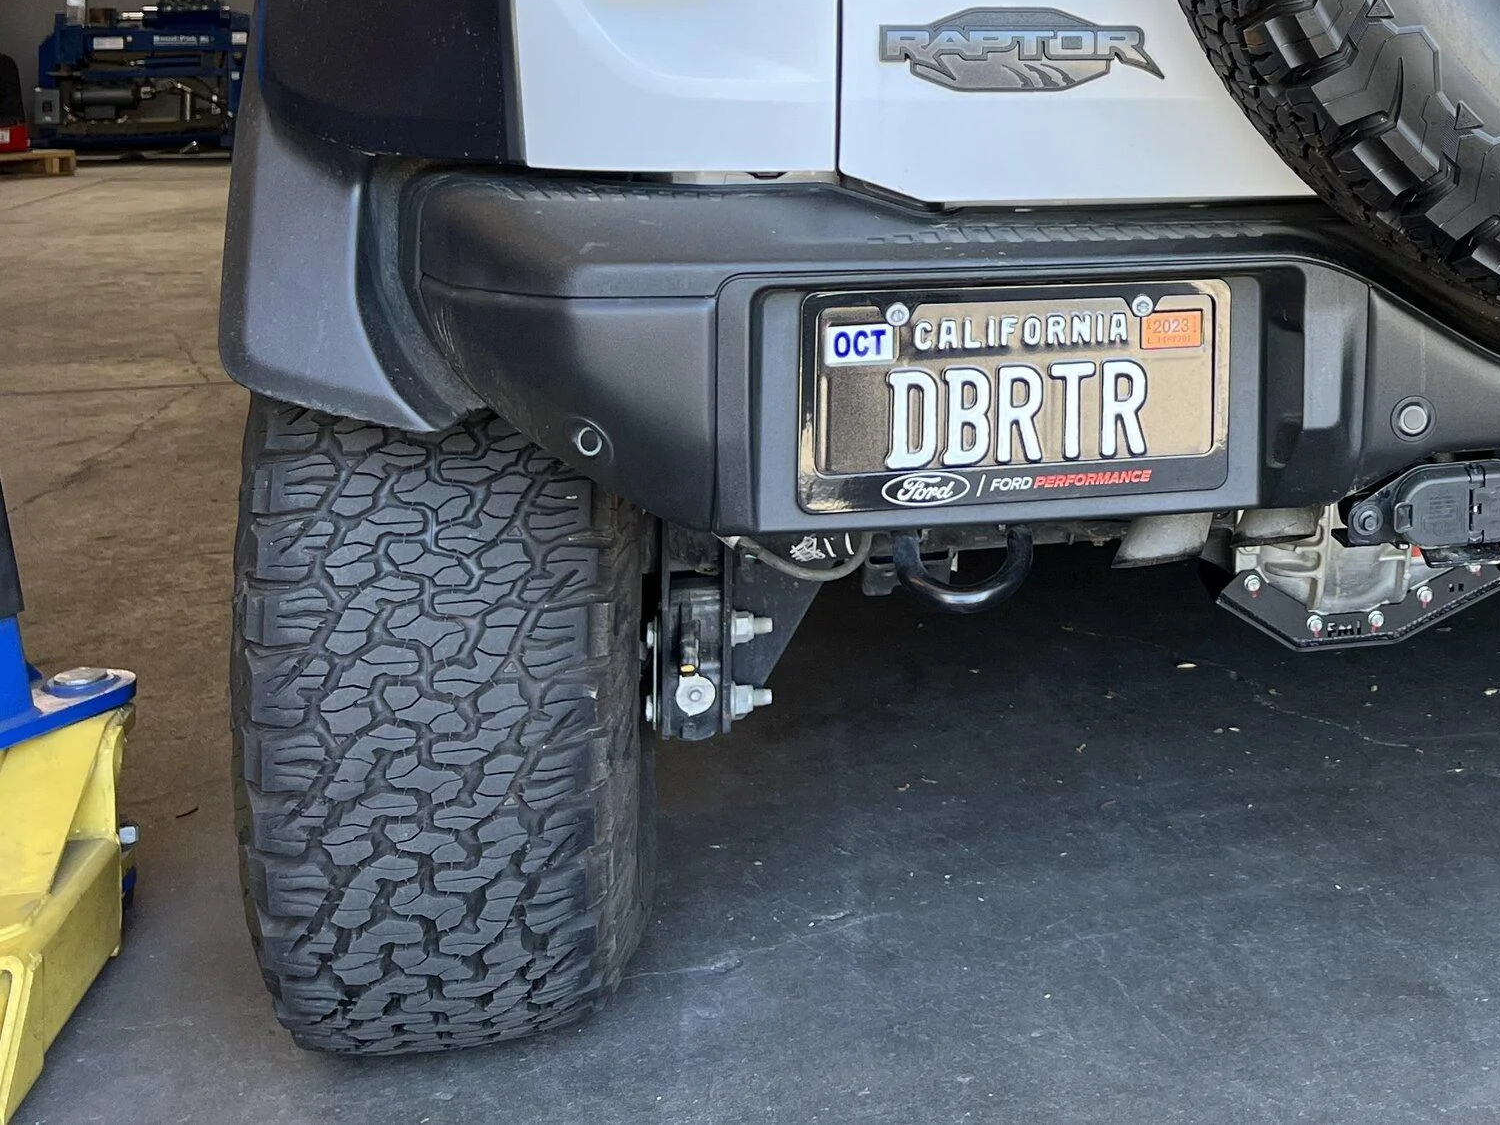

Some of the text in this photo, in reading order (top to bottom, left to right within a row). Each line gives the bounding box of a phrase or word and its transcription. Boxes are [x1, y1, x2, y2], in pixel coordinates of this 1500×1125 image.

[879, 24, 1165, 80] RAPTOR
[833, 328, 888, 358] OCT
[912, 311, 1130, 352] CALIFORNIA
[1153, 318, 1190, 334] 2023
[885, 357, 1149, 471] DBRTR
[895, 469, 1153, 502] Ford FORD PERFORMANCE
